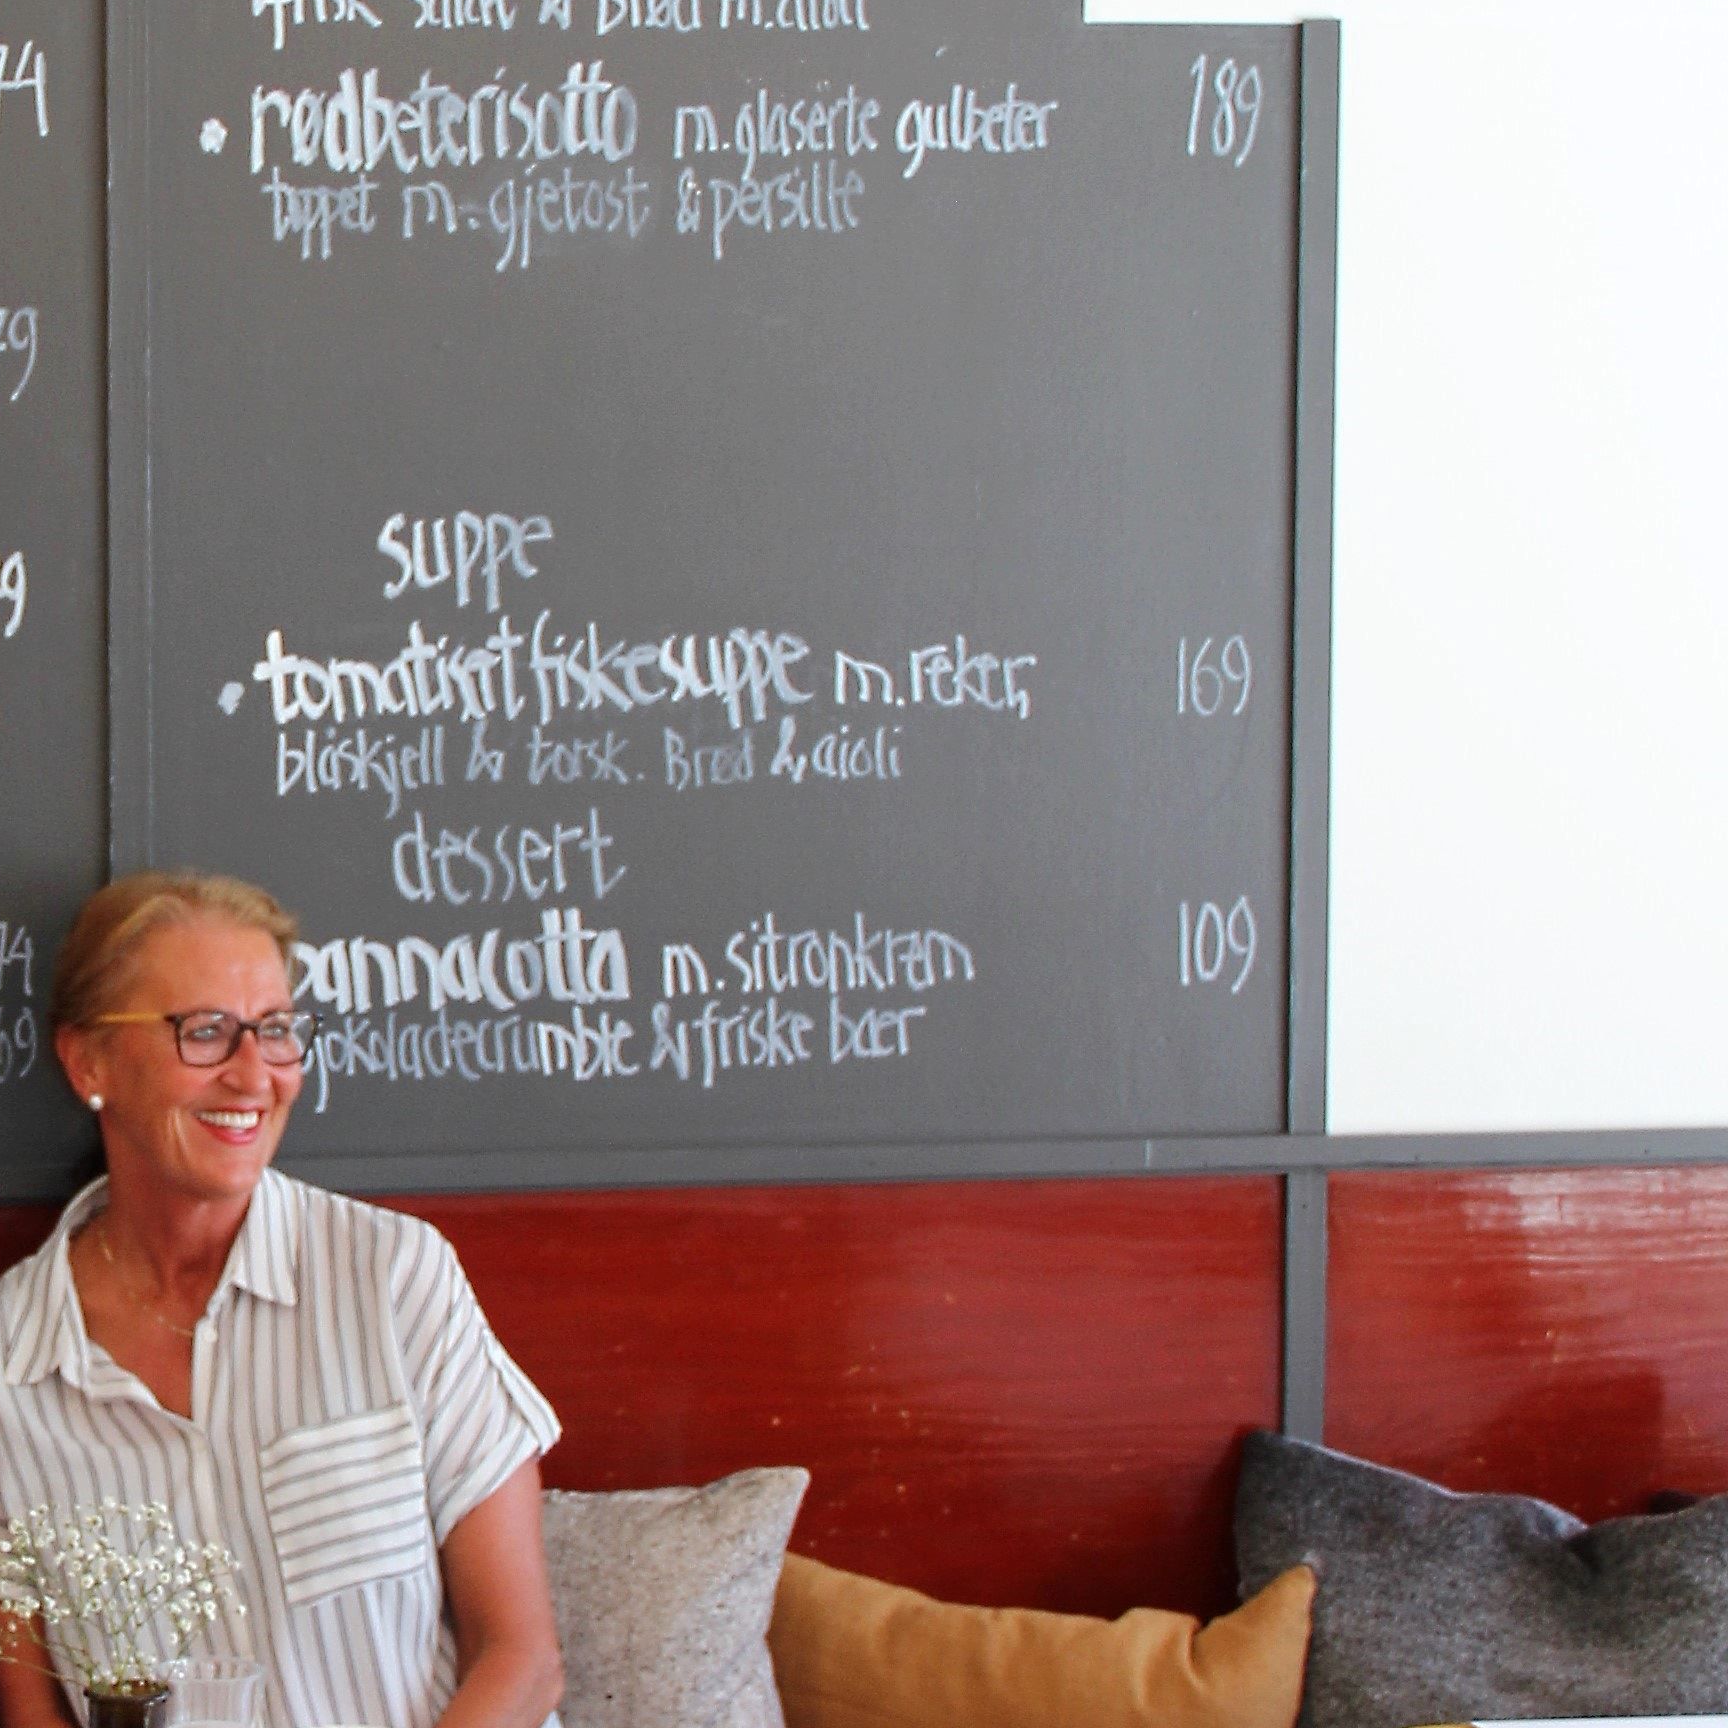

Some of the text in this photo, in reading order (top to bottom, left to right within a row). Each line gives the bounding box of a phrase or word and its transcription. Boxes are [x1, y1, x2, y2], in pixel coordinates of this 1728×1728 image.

[250, 60, 639, 174] rødbeterisotto
[1185, 52, 1264, 168] 189
[377, 510, 554, 612] suppe
[1177, 634, 1252, 718] 169
[392, 807, 626, 904] dessert
[1176, 896, 1256, 994] 109
